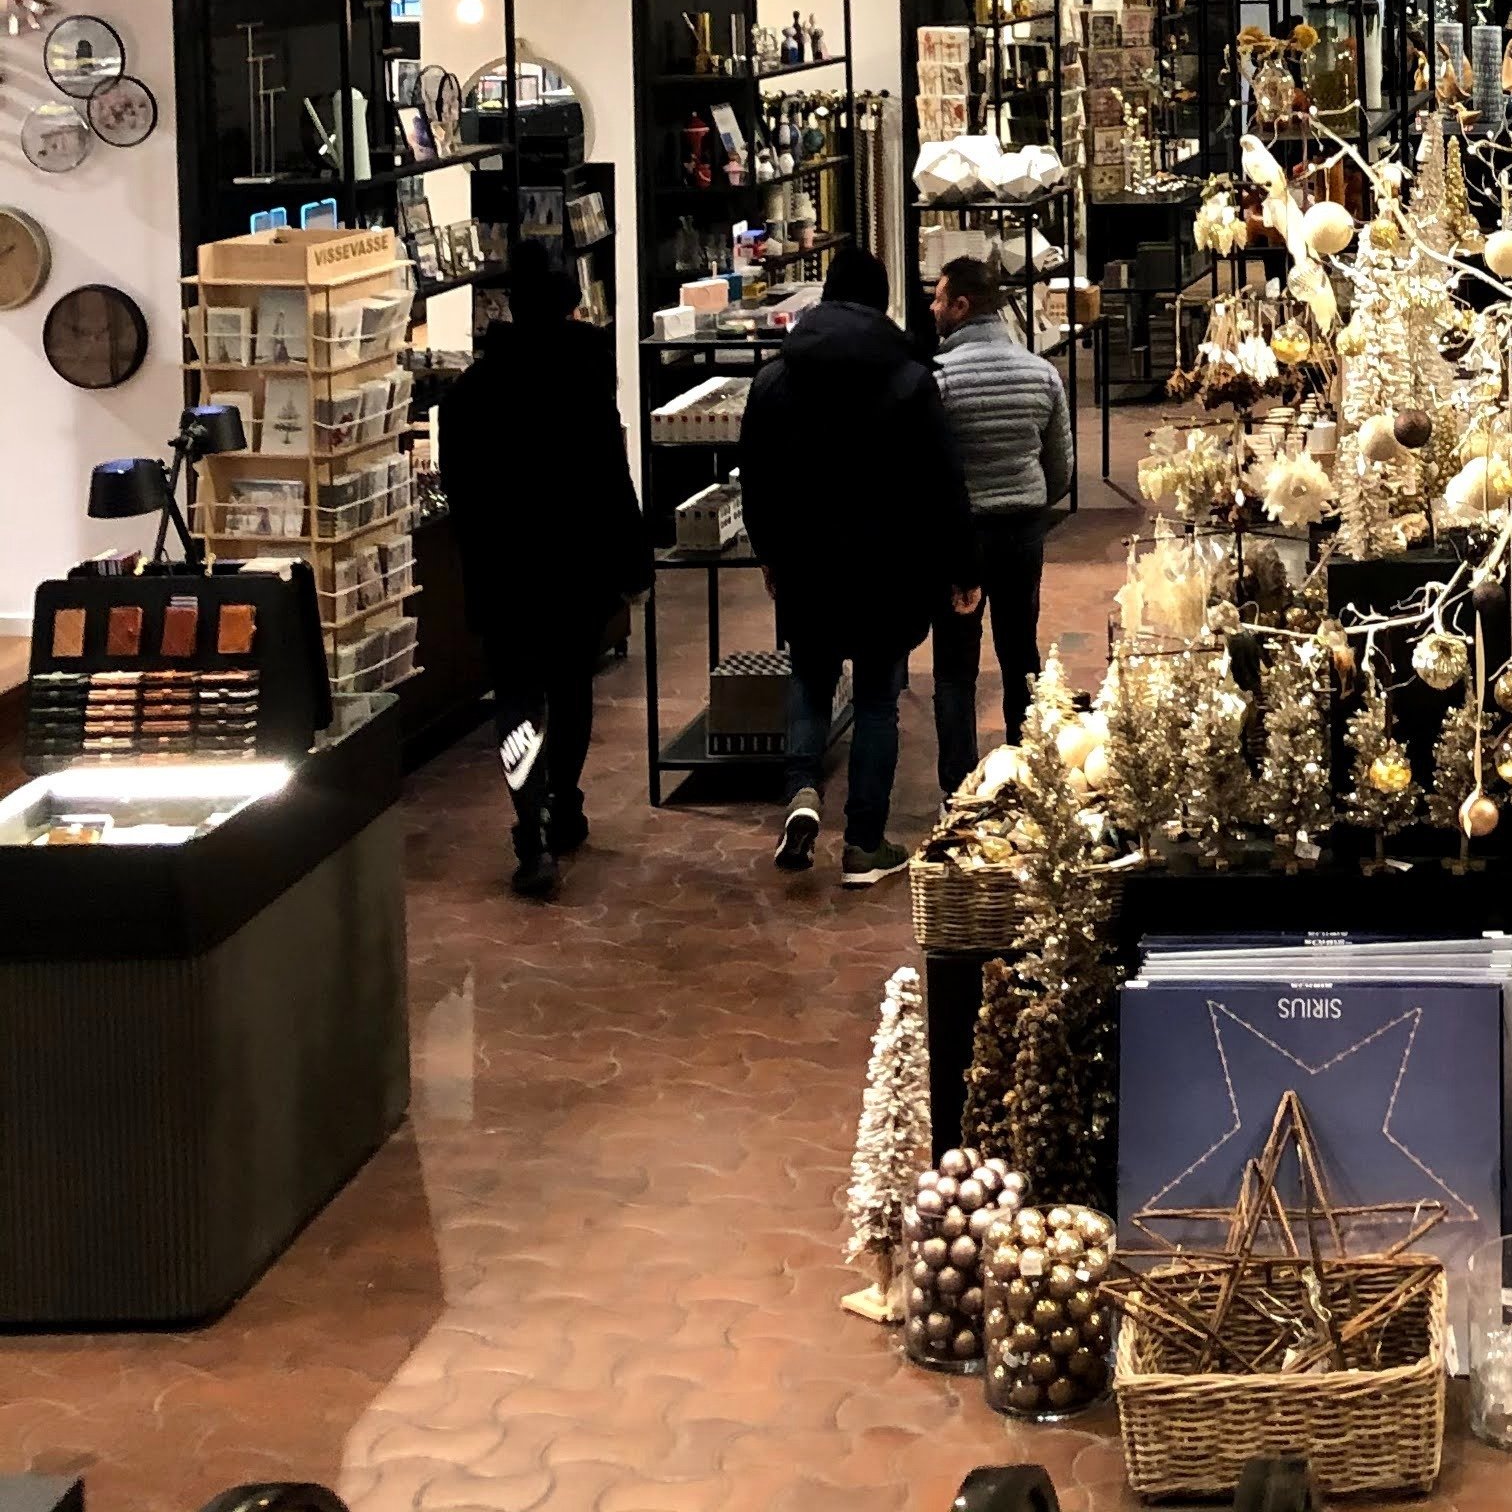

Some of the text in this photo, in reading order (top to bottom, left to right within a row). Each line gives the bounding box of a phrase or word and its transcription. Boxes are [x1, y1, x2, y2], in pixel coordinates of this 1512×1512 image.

[314, 234, 389, 266] VISSEVASSE
[500, 720, 536, 773] NIKE
[1278, 998, 1342, 1019] SIRIUS
